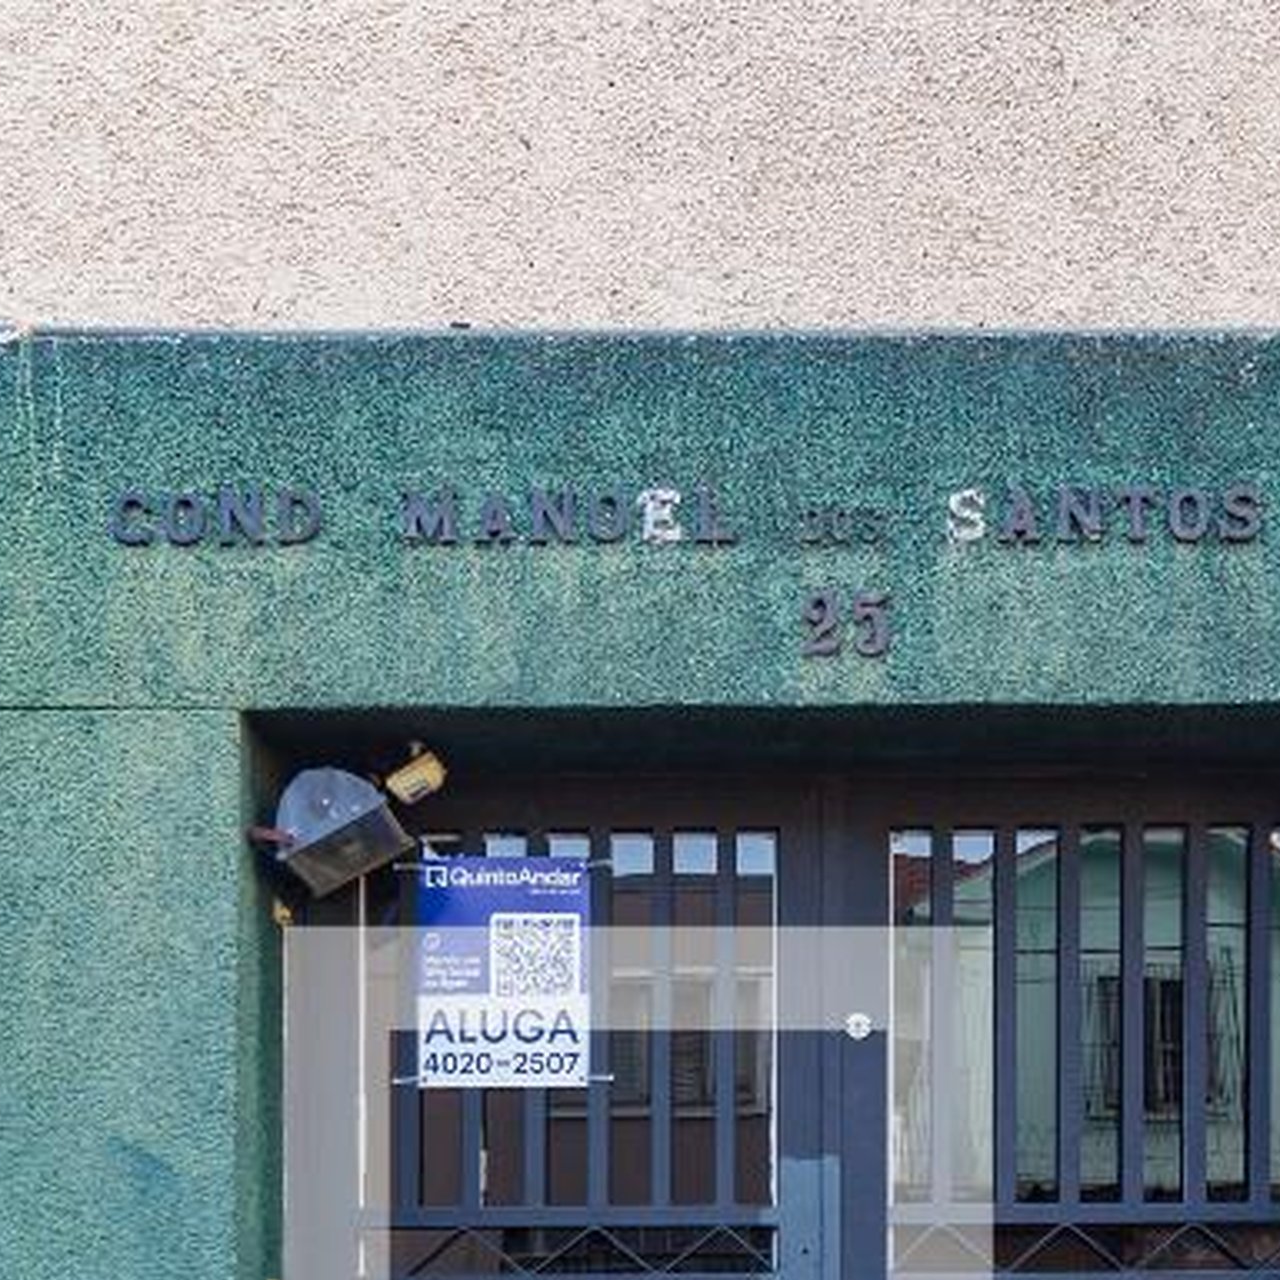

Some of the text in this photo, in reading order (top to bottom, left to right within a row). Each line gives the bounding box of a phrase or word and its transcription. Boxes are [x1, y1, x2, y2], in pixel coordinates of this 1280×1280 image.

[109, 487, 323, 547] COND
[406, 483, 740, 548] MANOEL
[947, 488, 1266, 546] SANTOS
[799, 588, 893, 657] 25
[450, 867, 581, 887] QuintoAndar
[424, 1008, 580, 1044] ALUGA
